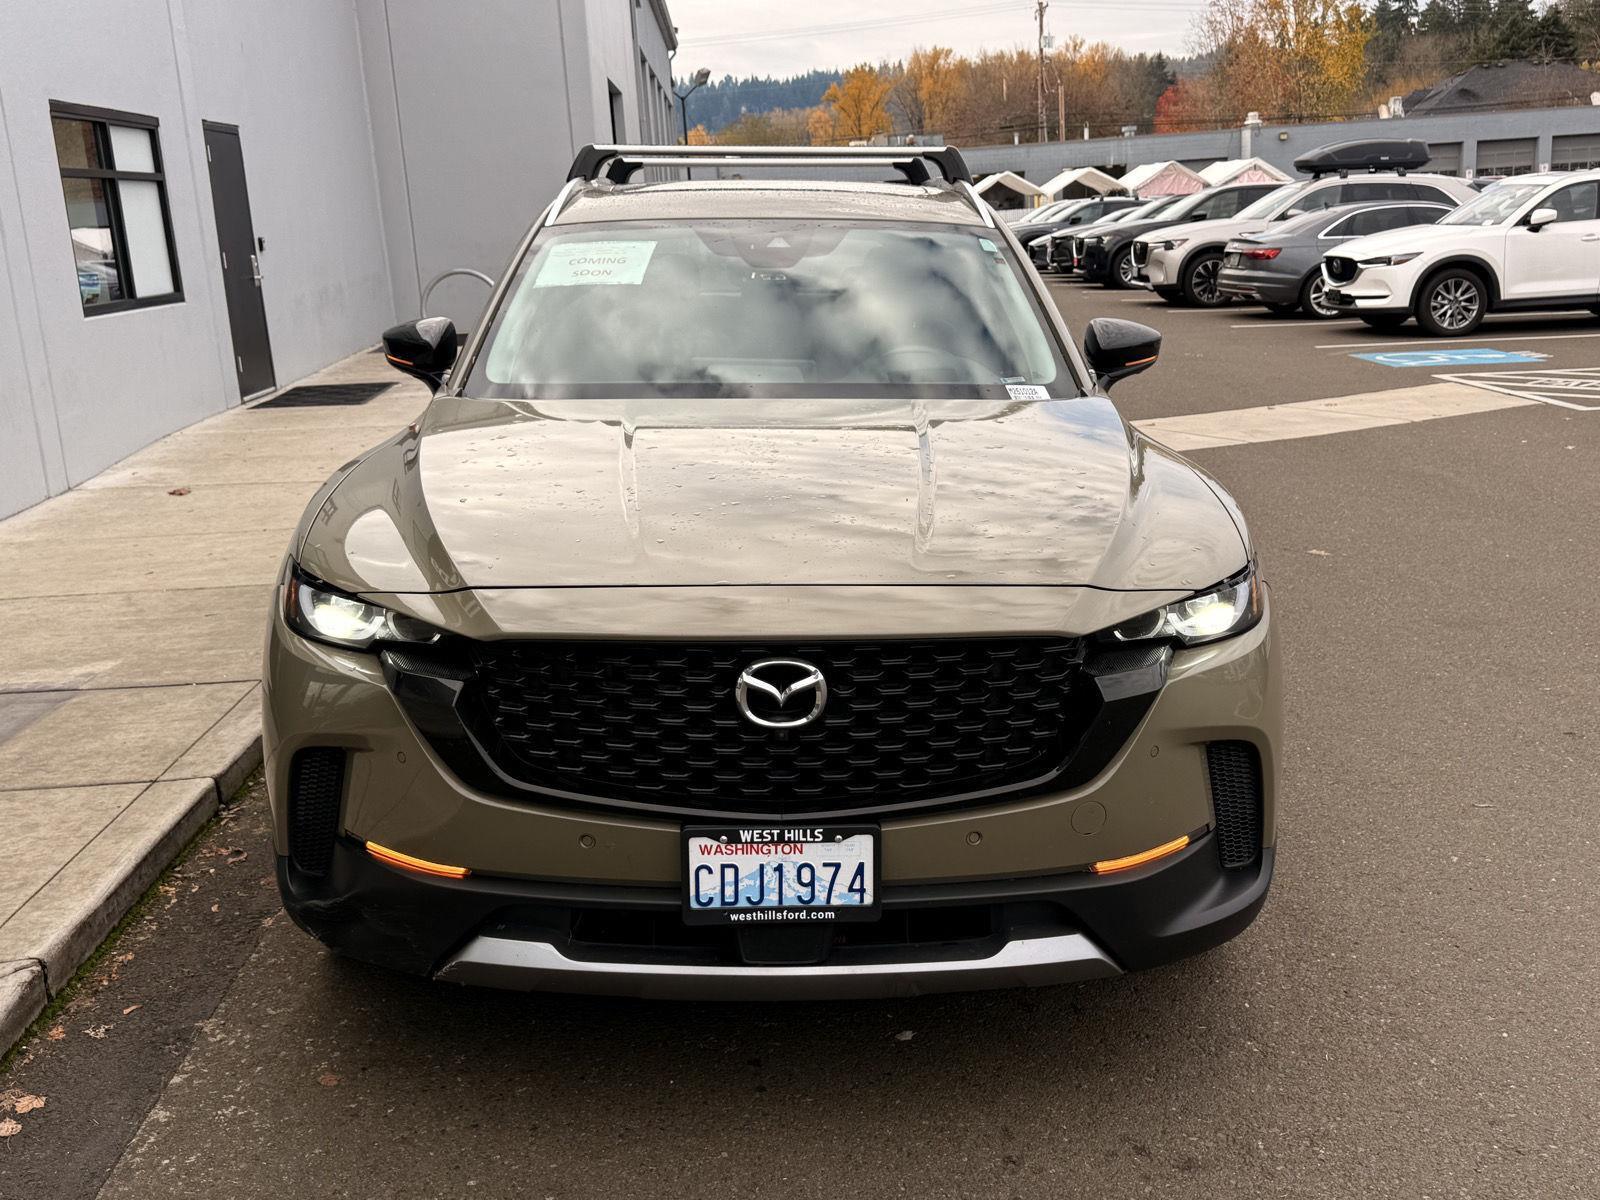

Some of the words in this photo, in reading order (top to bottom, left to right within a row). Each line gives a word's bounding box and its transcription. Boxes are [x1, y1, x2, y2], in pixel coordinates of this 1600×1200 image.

[568, 257, 627, 266] COMING
[571, 269, 613, 277] SOON
[739, 829, 781, 842] WEST
[784, 828, 824, 842] HILLS
[699, 843, 804, 856] WASHINGTON
[694, 861, 866, 907] CDJ1974
[730, 909, 835, 921] westhillsford.com
